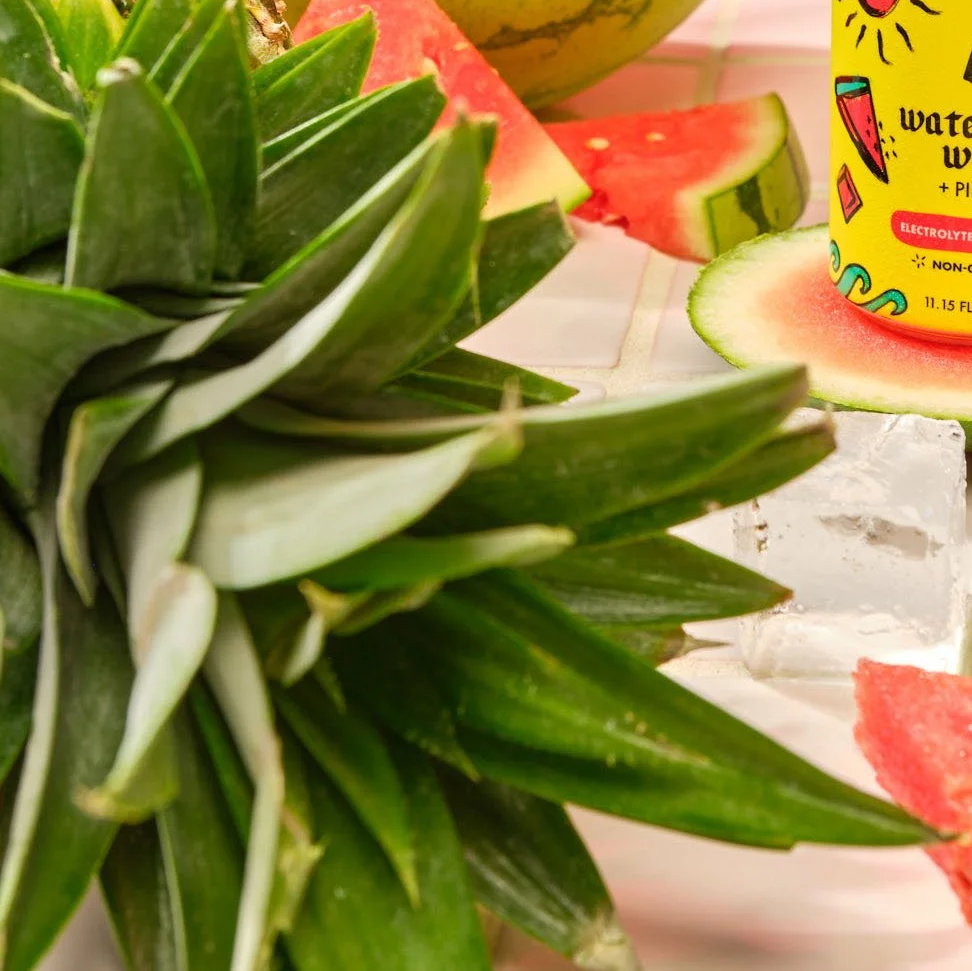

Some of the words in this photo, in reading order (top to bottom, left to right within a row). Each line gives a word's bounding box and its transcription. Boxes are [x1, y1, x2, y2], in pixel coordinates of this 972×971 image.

[938, 182, 950, 194] +
[924, 296, 955, 311] 11.15
[960, 302, 972, 313] FL
